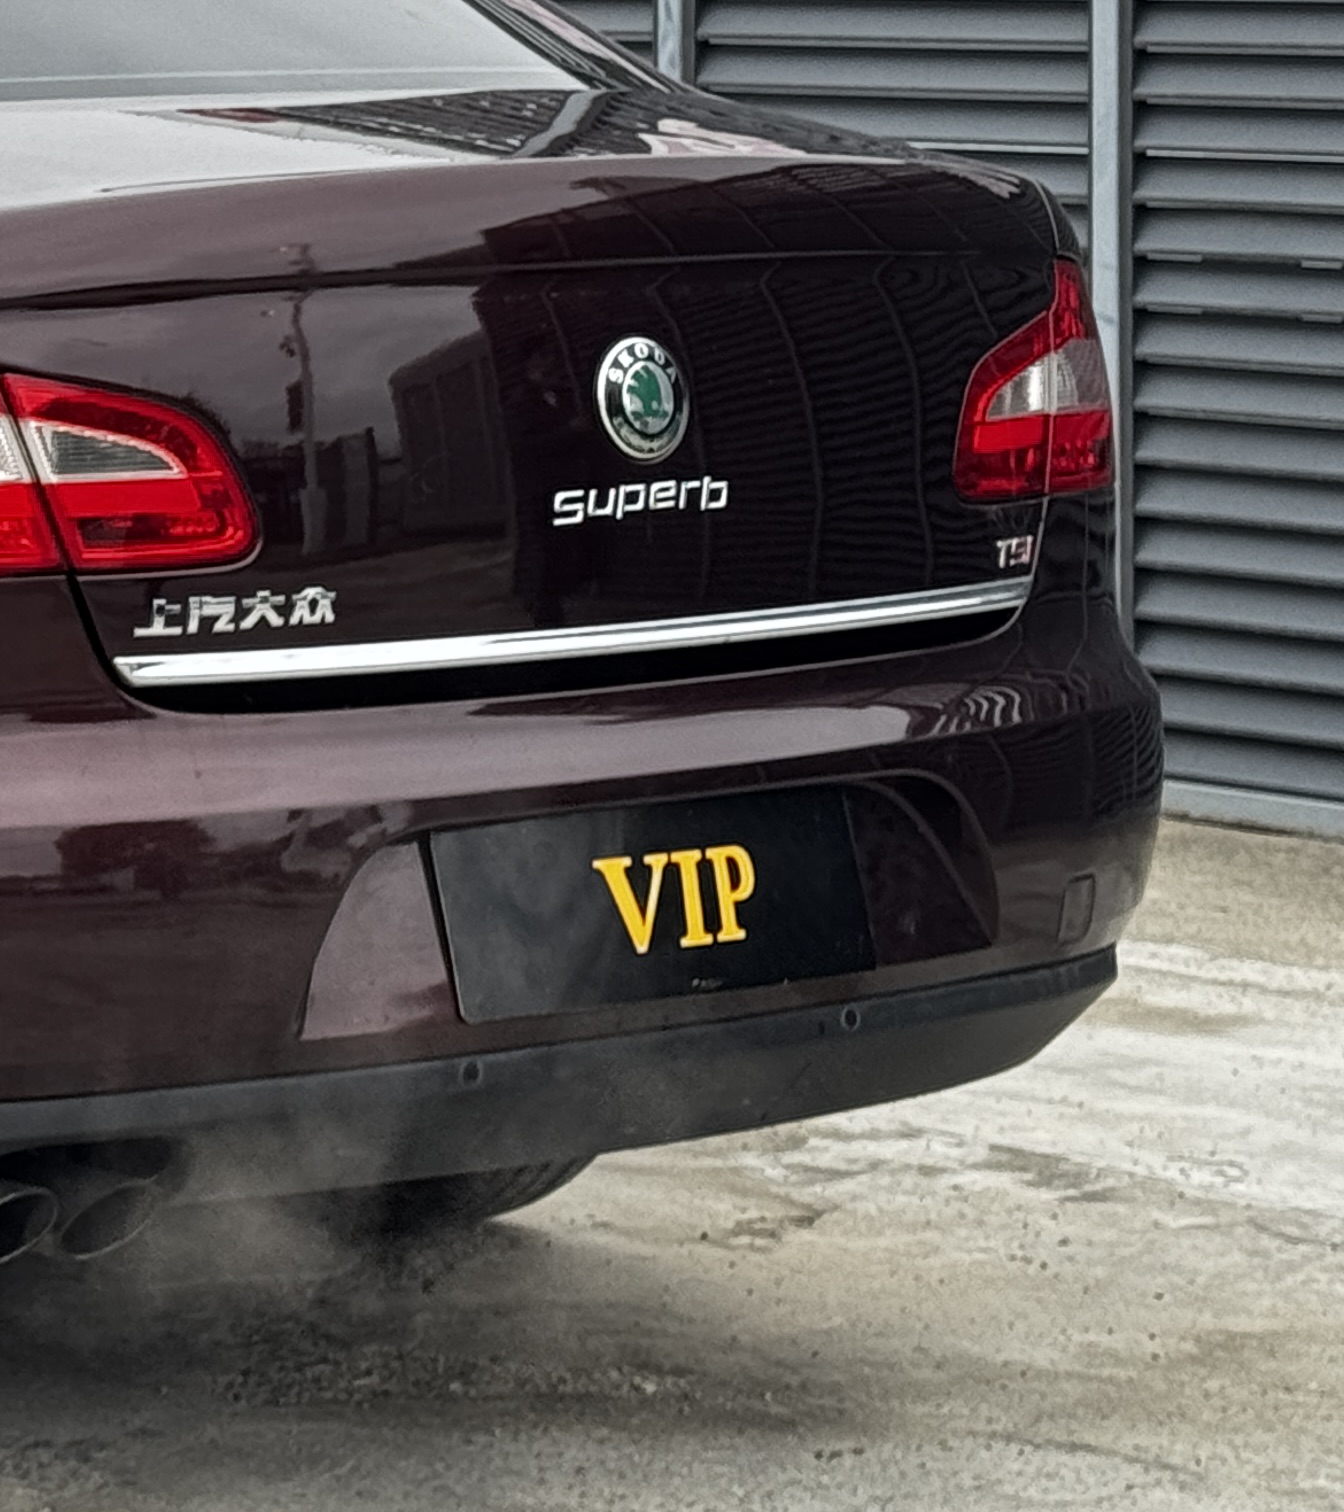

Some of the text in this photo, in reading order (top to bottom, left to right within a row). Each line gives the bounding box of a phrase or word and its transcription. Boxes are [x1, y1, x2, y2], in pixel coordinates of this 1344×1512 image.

[133, 586, 337, 638] 上汽大众
[592, 844, 756, 955] VIP
